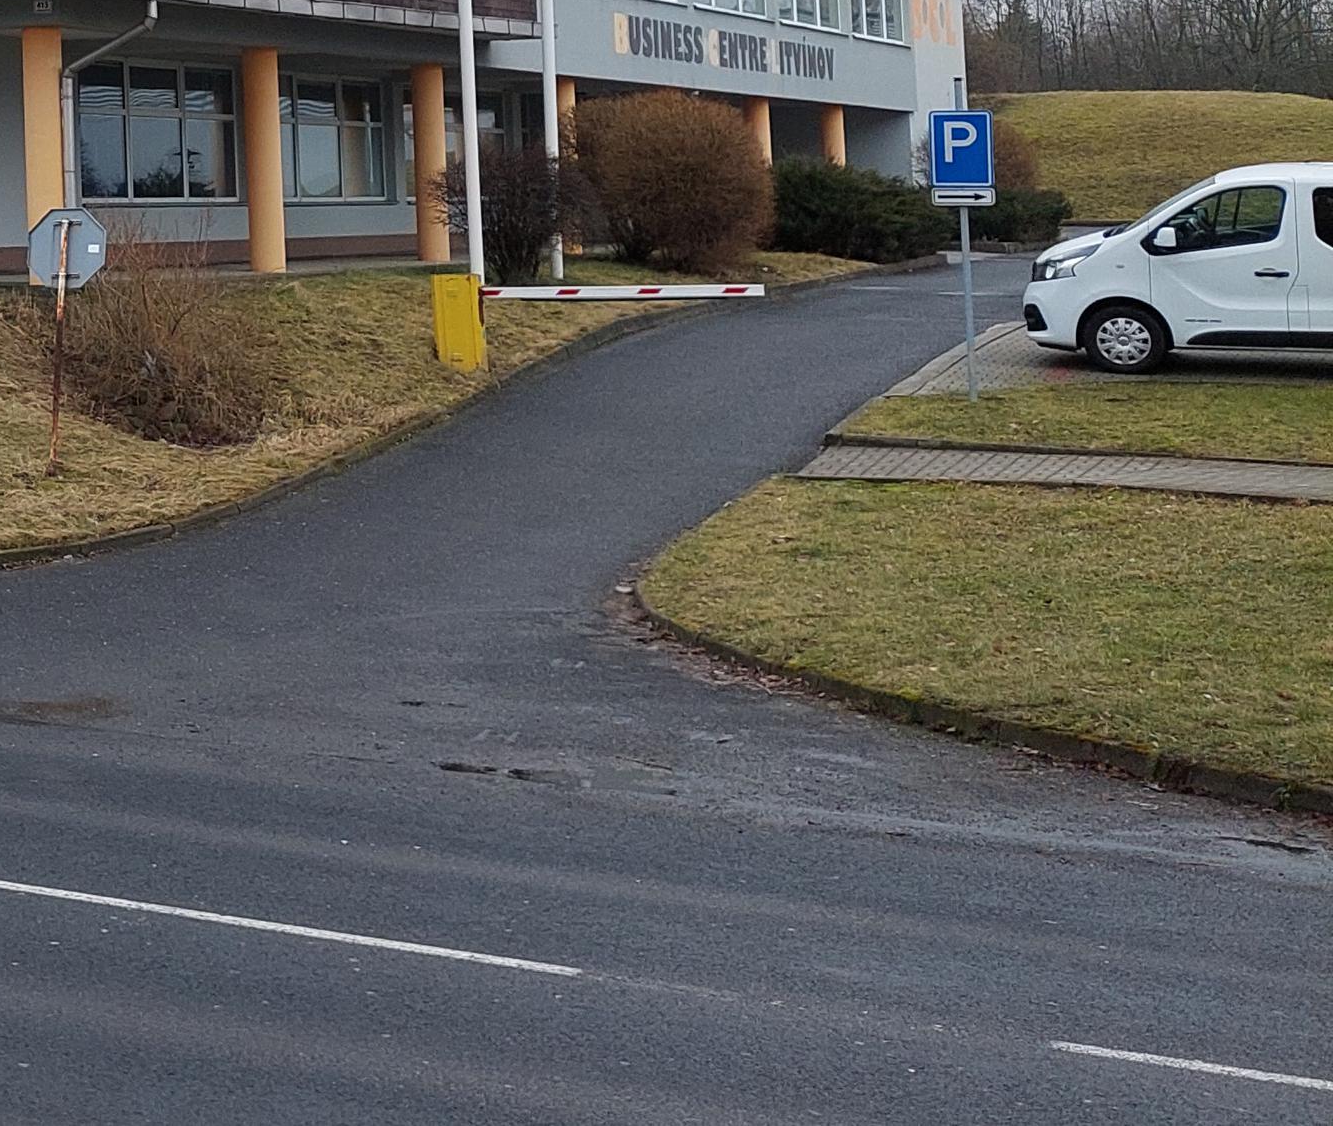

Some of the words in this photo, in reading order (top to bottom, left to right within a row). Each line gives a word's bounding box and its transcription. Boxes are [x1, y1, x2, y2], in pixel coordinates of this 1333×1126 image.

[613, 12, 704, 64] BUSINESS
[708, 28, 768, 73] CENTRE
[943, 121, 977, 163] P
